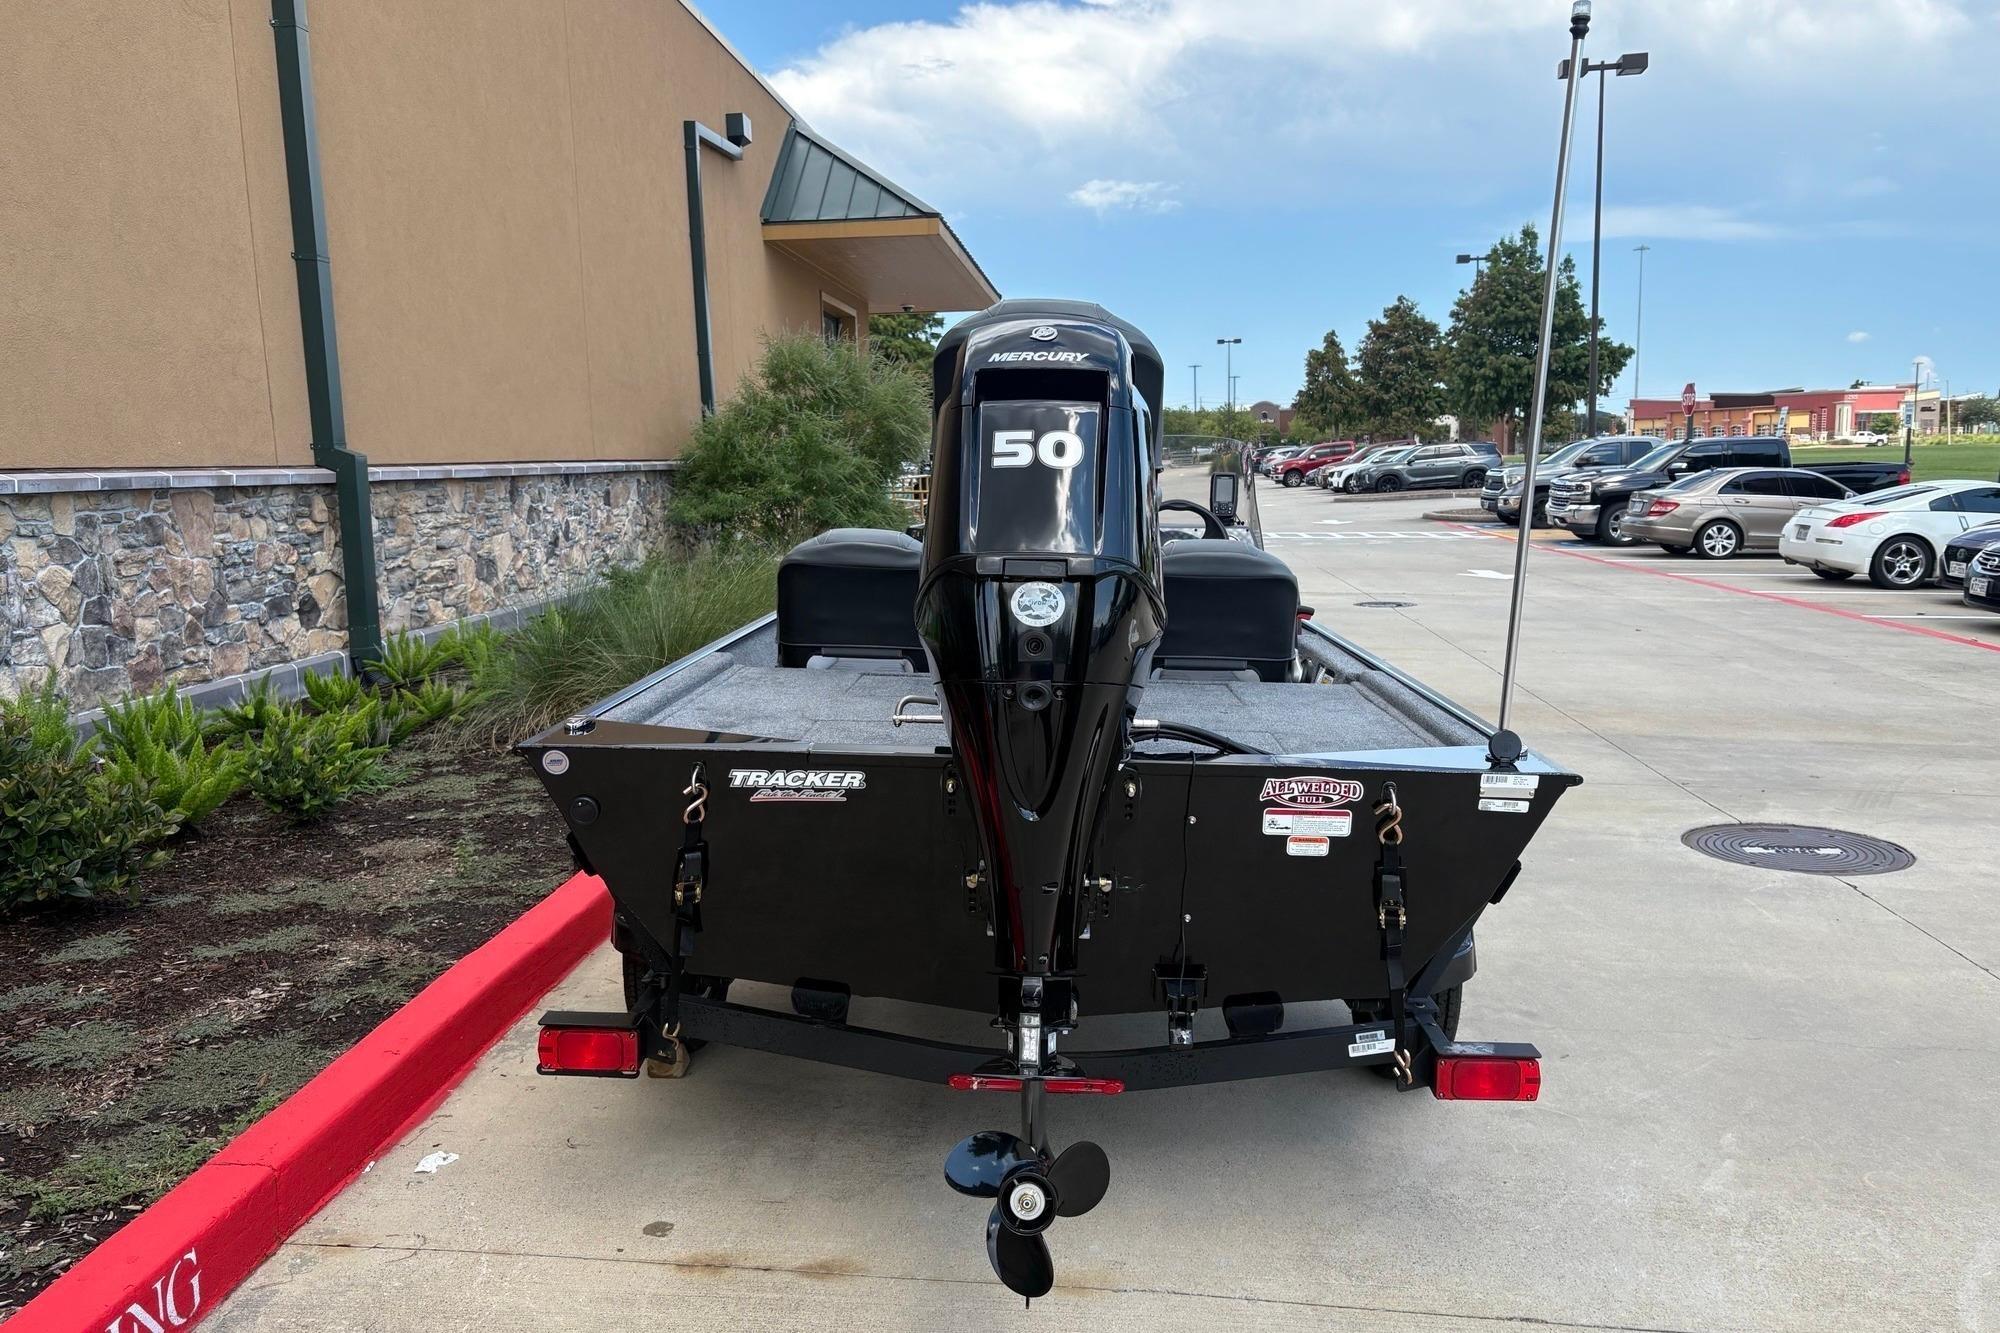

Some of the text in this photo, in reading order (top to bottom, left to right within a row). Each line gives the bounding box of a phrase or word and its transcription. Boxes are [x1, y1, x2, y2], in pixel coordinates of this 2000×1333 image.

[988, 351, 1090, 362] MERCURY
[1683, 393, 1695, 406] STOP
[991, 429, 1084, 469] 50
[729, 769, 864, 788] TRACKER
[1263, 780, 1361, 799] ALL WELDED
[1297, 796, 1326, 804] HULL
[105, 1246, 202, 1333] NG
